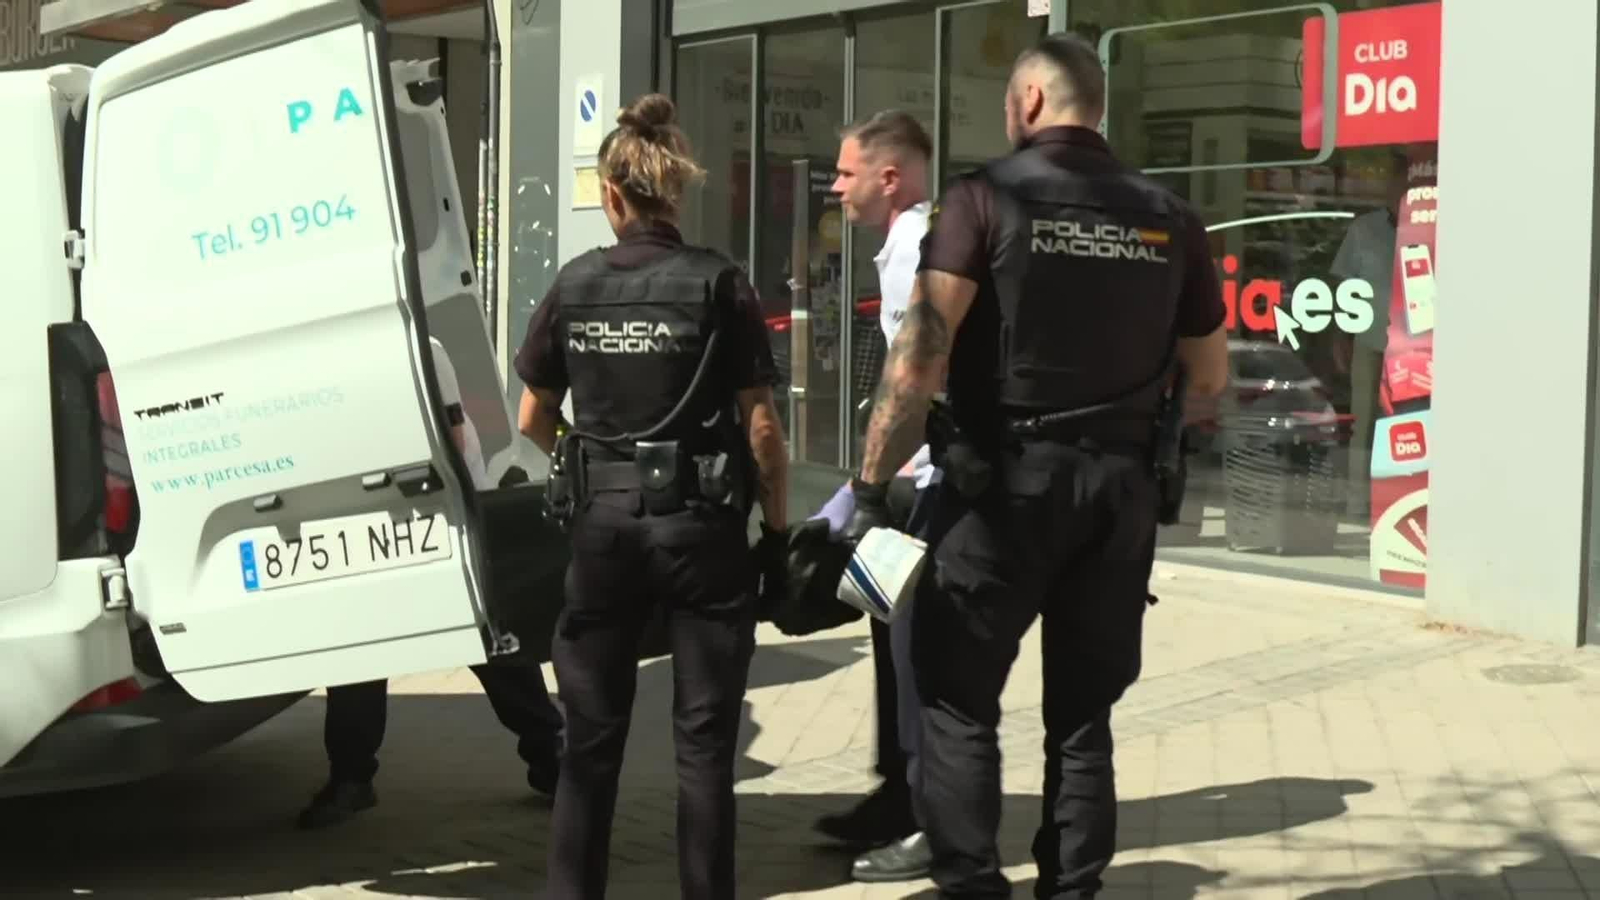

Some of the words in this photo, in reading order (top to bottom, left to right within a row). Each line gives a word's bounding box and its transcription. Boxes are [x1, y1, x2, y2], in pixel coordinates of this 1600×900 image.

[1354, 39, 1408, 63] CLUB
[192, 224, 243, 260] Tel.
[251, 212, 281, 244] 91
[291, 193, 357, 233] 904
[1032, 219, 1142, 243] POLICIA
[1031, 237, 1168, 263] NACIONAL
[568, 321, 672, 337] POLICIA
[134, 391, 224, 420] TRANSIT
[143, 432, 242, 465] INTEGRALES
[151, 453, 295, 494] www.parcesa.es
[265, 530, 349, 578] 8751
[368, 515, 439, 561] NHZ
